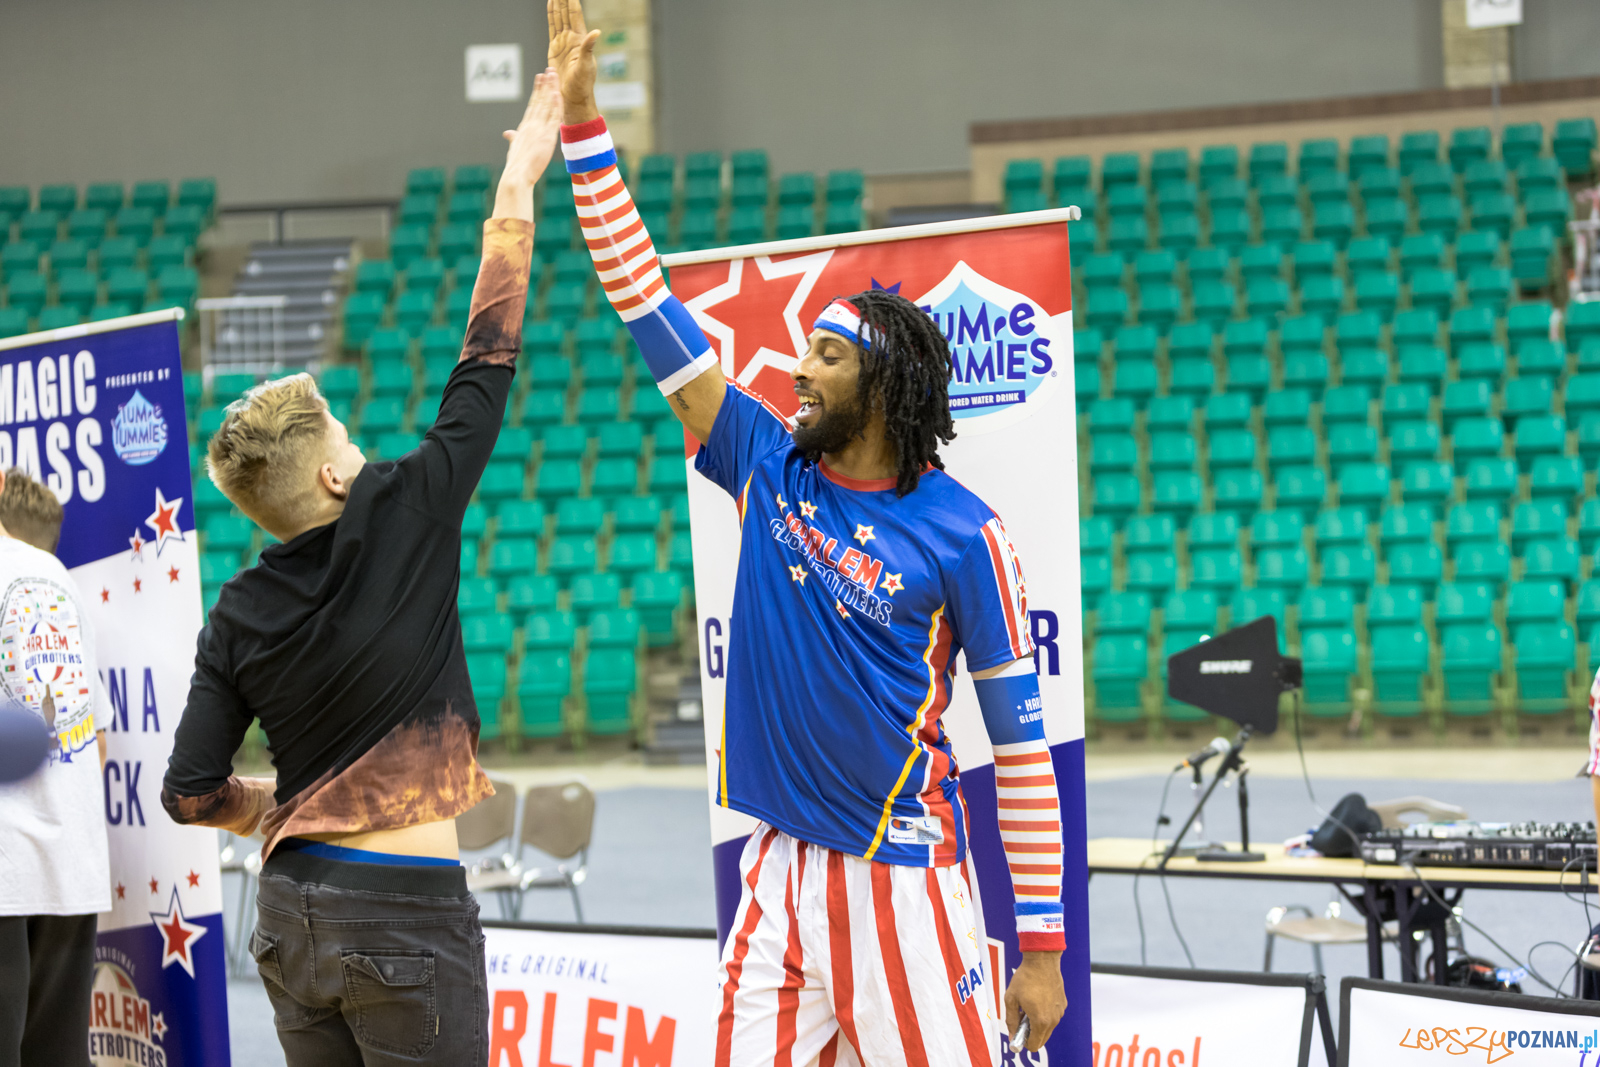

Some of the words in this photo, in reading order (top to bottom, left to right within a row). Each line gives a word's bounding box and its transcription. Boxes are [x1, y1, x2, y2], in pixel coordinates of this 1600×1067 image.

[157, 367, 170, 381] BY
[971, 395, 994, 405] WATER
[996, 392, 1020, 403] DRINK
[1199, 660, 1253, 674] SHURE
[520, 954, 609, 984] ORIGINAL
